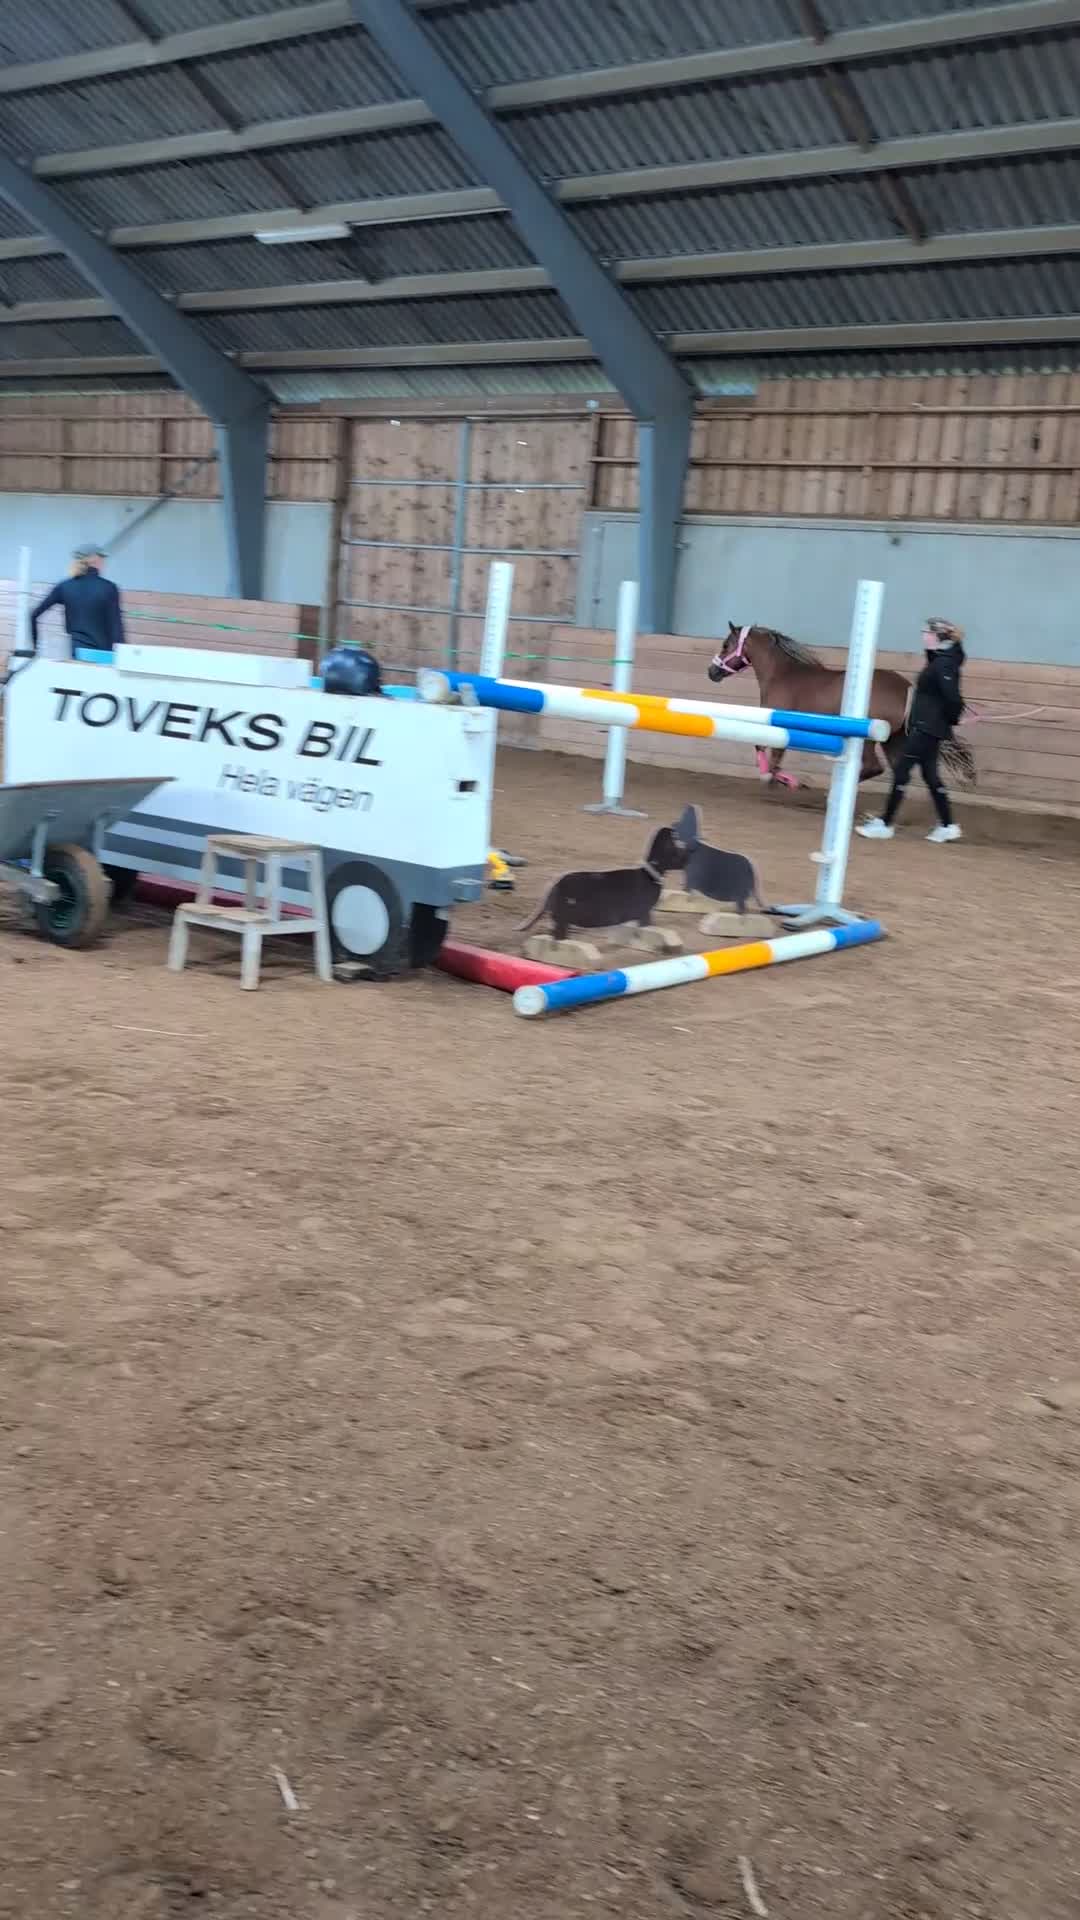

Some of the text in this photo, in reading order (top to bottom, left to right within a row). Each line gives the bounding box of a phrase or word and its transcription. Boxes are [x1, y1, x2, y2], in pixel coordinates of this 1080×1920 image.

[51, 687, 383, 766] TOVEKS BIL
[219, 764, 374, 812] Hela vägen
